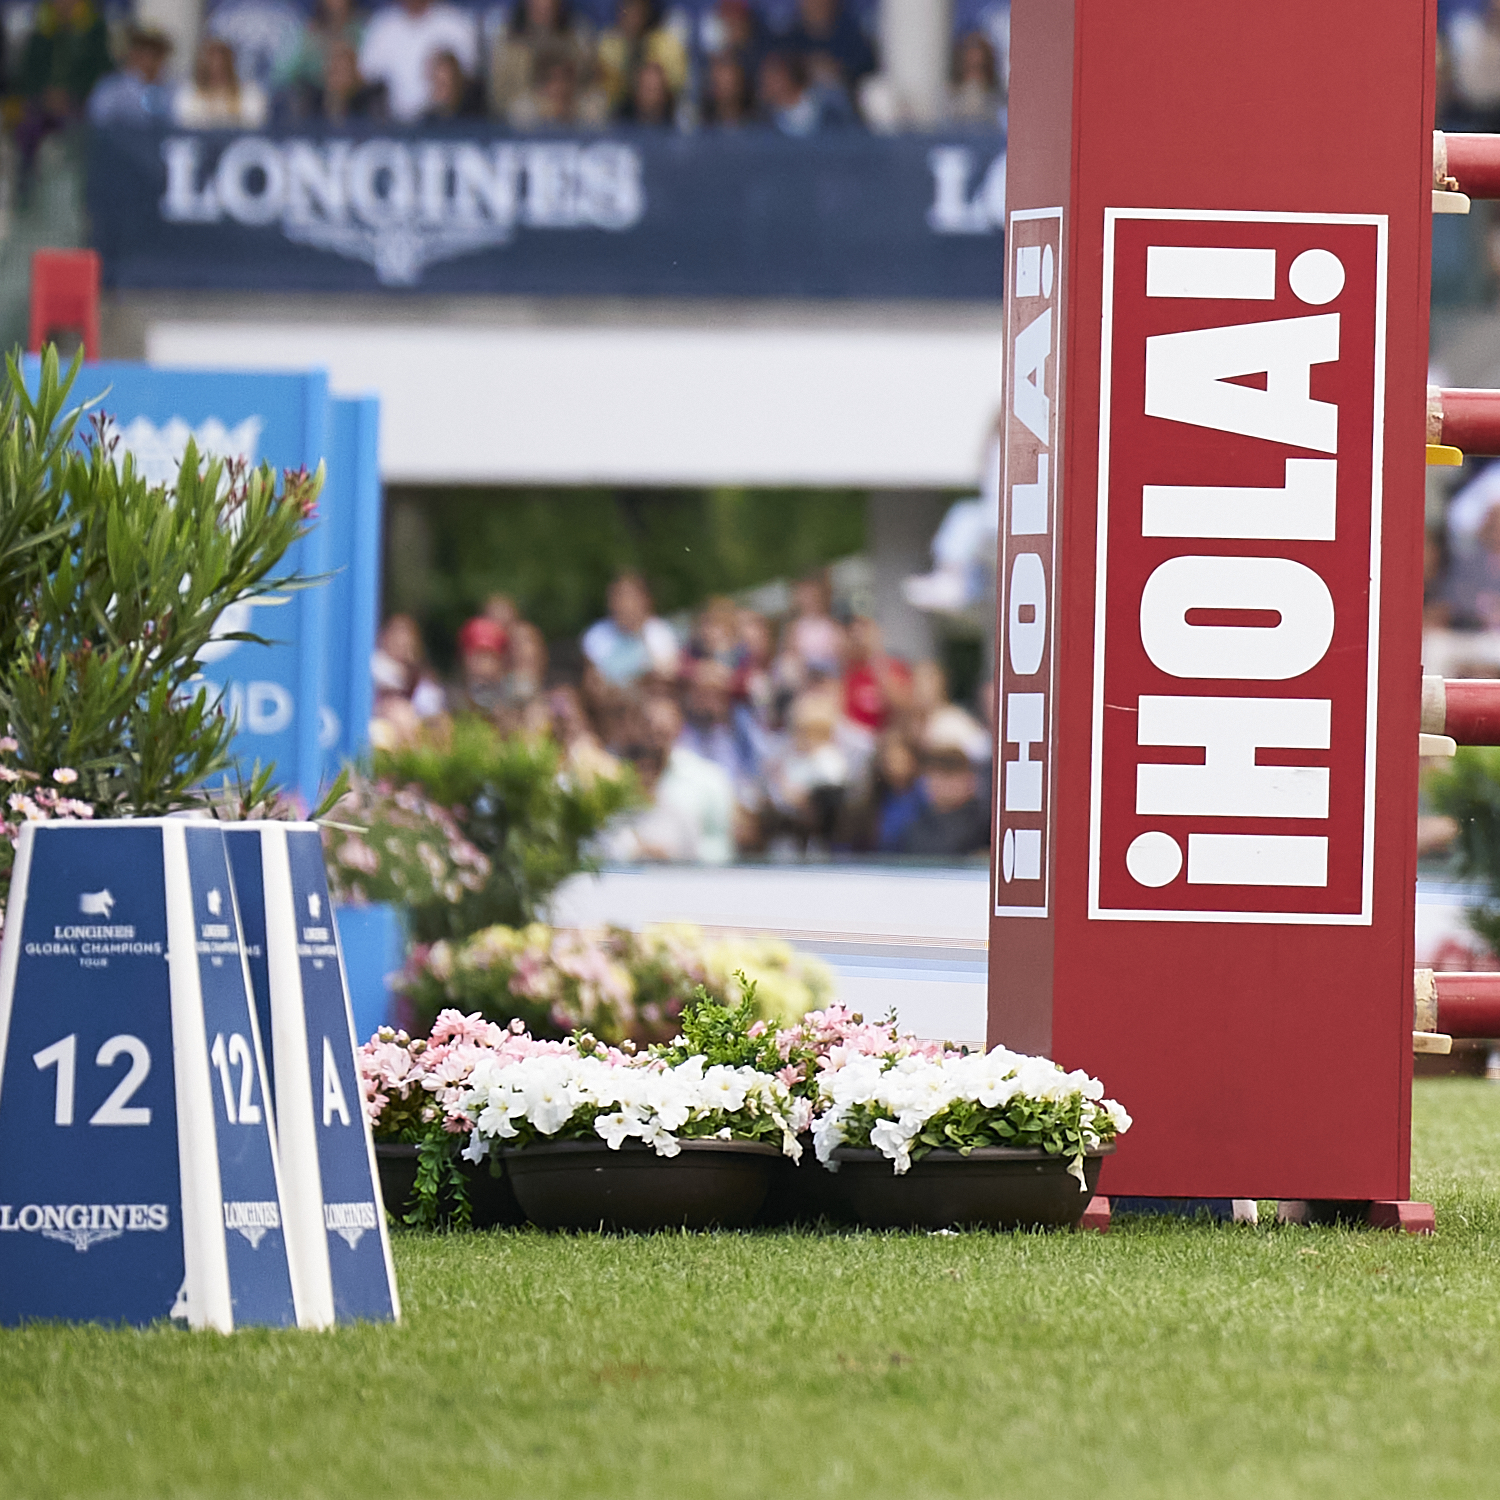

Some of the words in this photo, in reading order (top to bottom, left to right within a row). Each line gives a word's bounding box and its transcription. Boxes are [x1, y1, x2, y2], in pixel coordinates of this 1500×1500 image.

[162, 137, 641, 231] LONGINES
[1003, 244, 1054, 884] ¡HOLA!
[1126, 245, 1346, 888] ¡HOLA!
[25, 942, 76, 955] GLOBAL
[81, 942, 163, 956] CHAMPIONS
[54, 925, 135, 939] LONGINES
[32, 1033, 151, 1126] 12
[211, 1032, 261, 1125] 12
[323, 1035, 350, 1127] A
[0, 1204, 169, 1231] LONGINES
[223, 1201, 280, 1228] LONGINES
[324, 1202, 378, 1230] LONGINES
